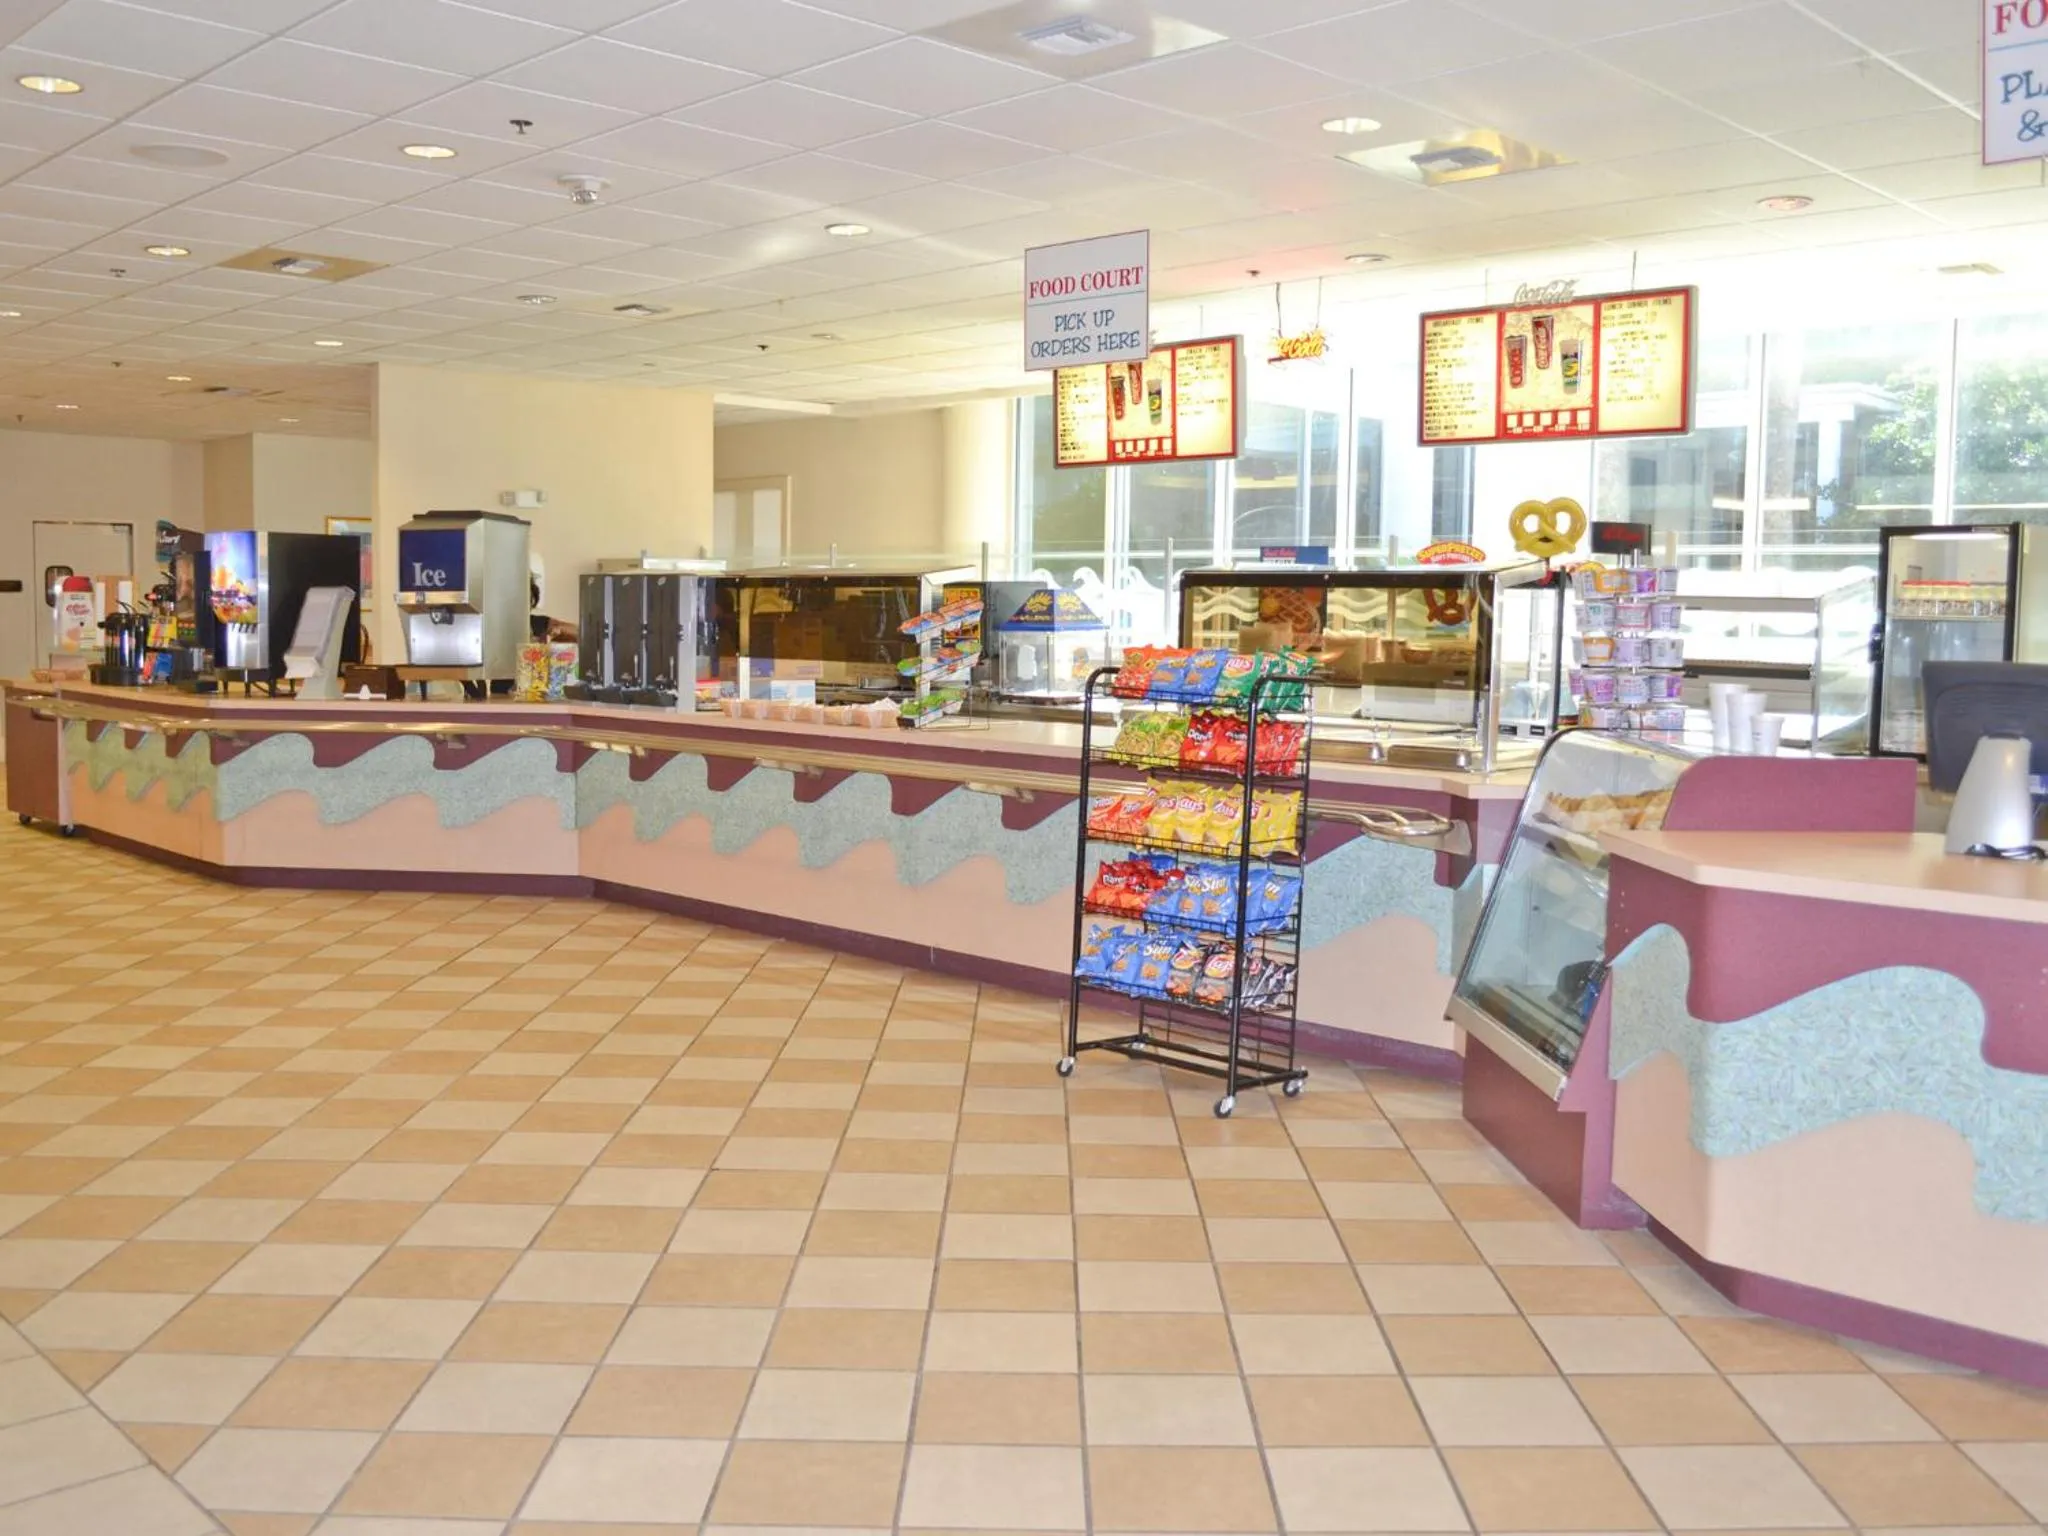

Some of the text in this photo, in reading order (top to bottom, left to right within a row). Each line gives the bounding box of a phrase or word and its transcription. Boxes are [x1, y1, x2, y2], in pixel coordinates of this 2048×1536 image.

[2000, 70, 2048, 104] PL
[1029, 266, 1143, 299] FOOD COURT
[1054, 309, 1115, 333] PICK UP
[1030, 331, 1140, 358] ORDERS HERE
[412, 562, 447, 587] Ice
